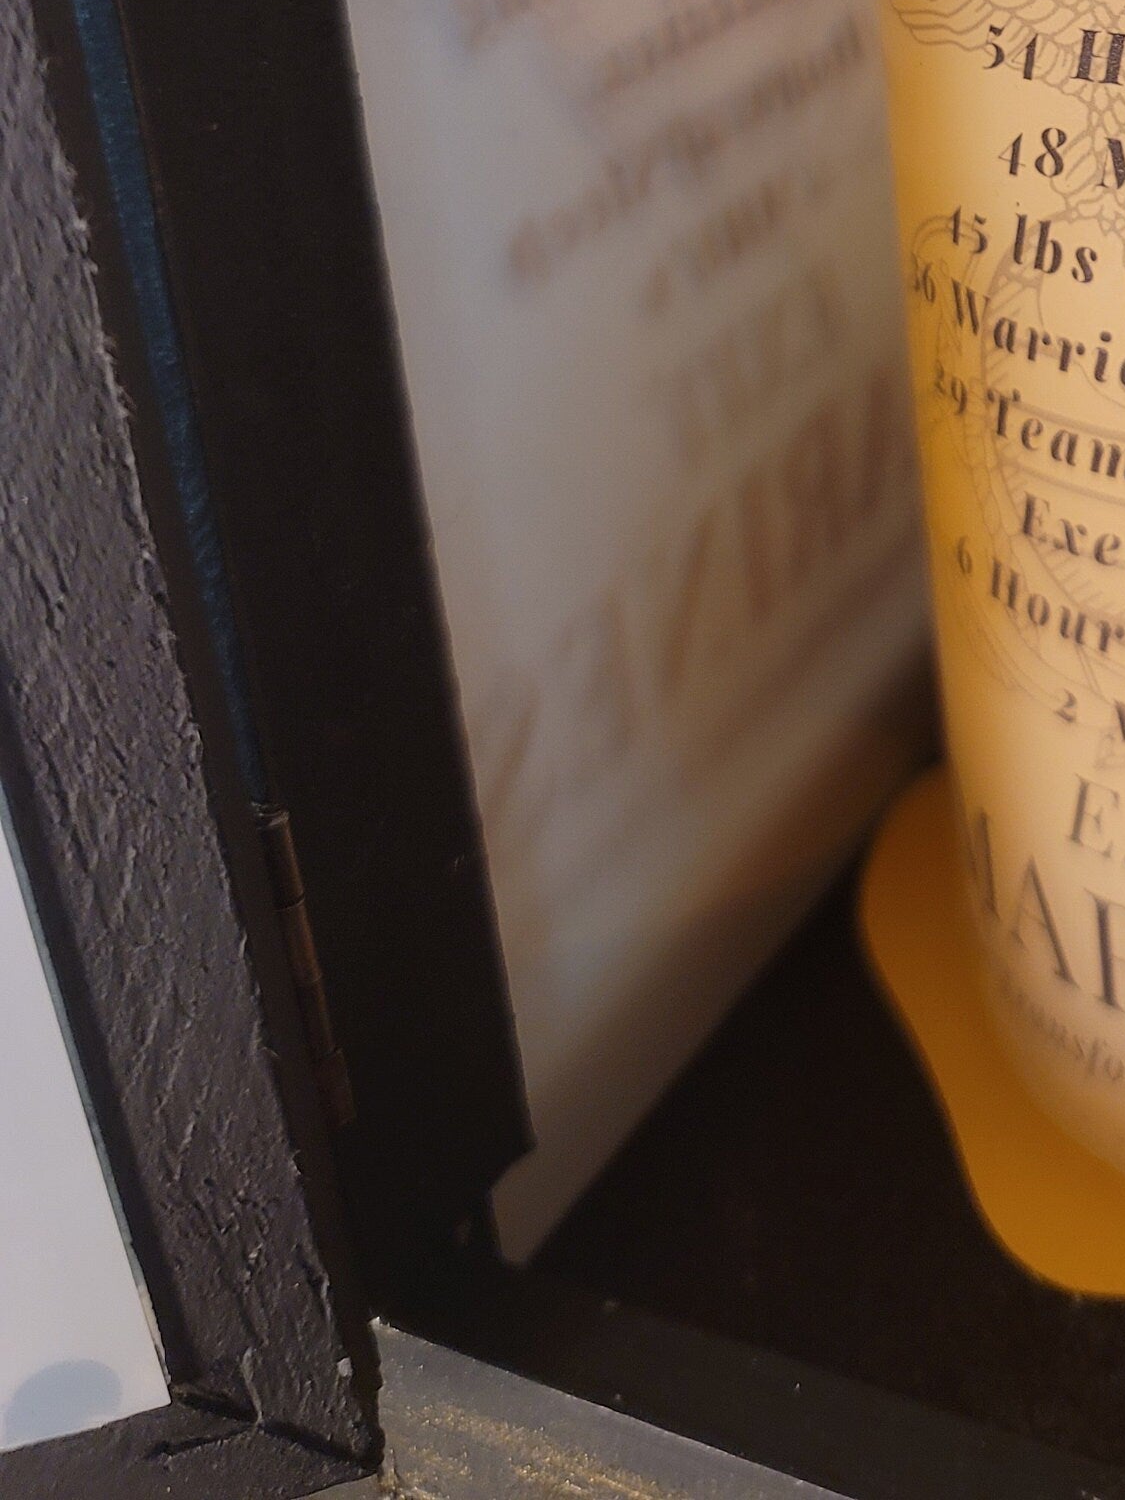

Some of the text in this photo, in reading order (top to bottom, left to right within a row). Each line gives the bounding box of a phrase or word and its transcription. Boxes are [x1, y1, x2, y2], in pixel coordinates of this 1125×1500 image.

[983, 23, 1041, 82] 54
[997, 126, 1069, 179] 48
[1012, 212, 1099, 284] lbs
[1054, 687, 1079, 725] 2
